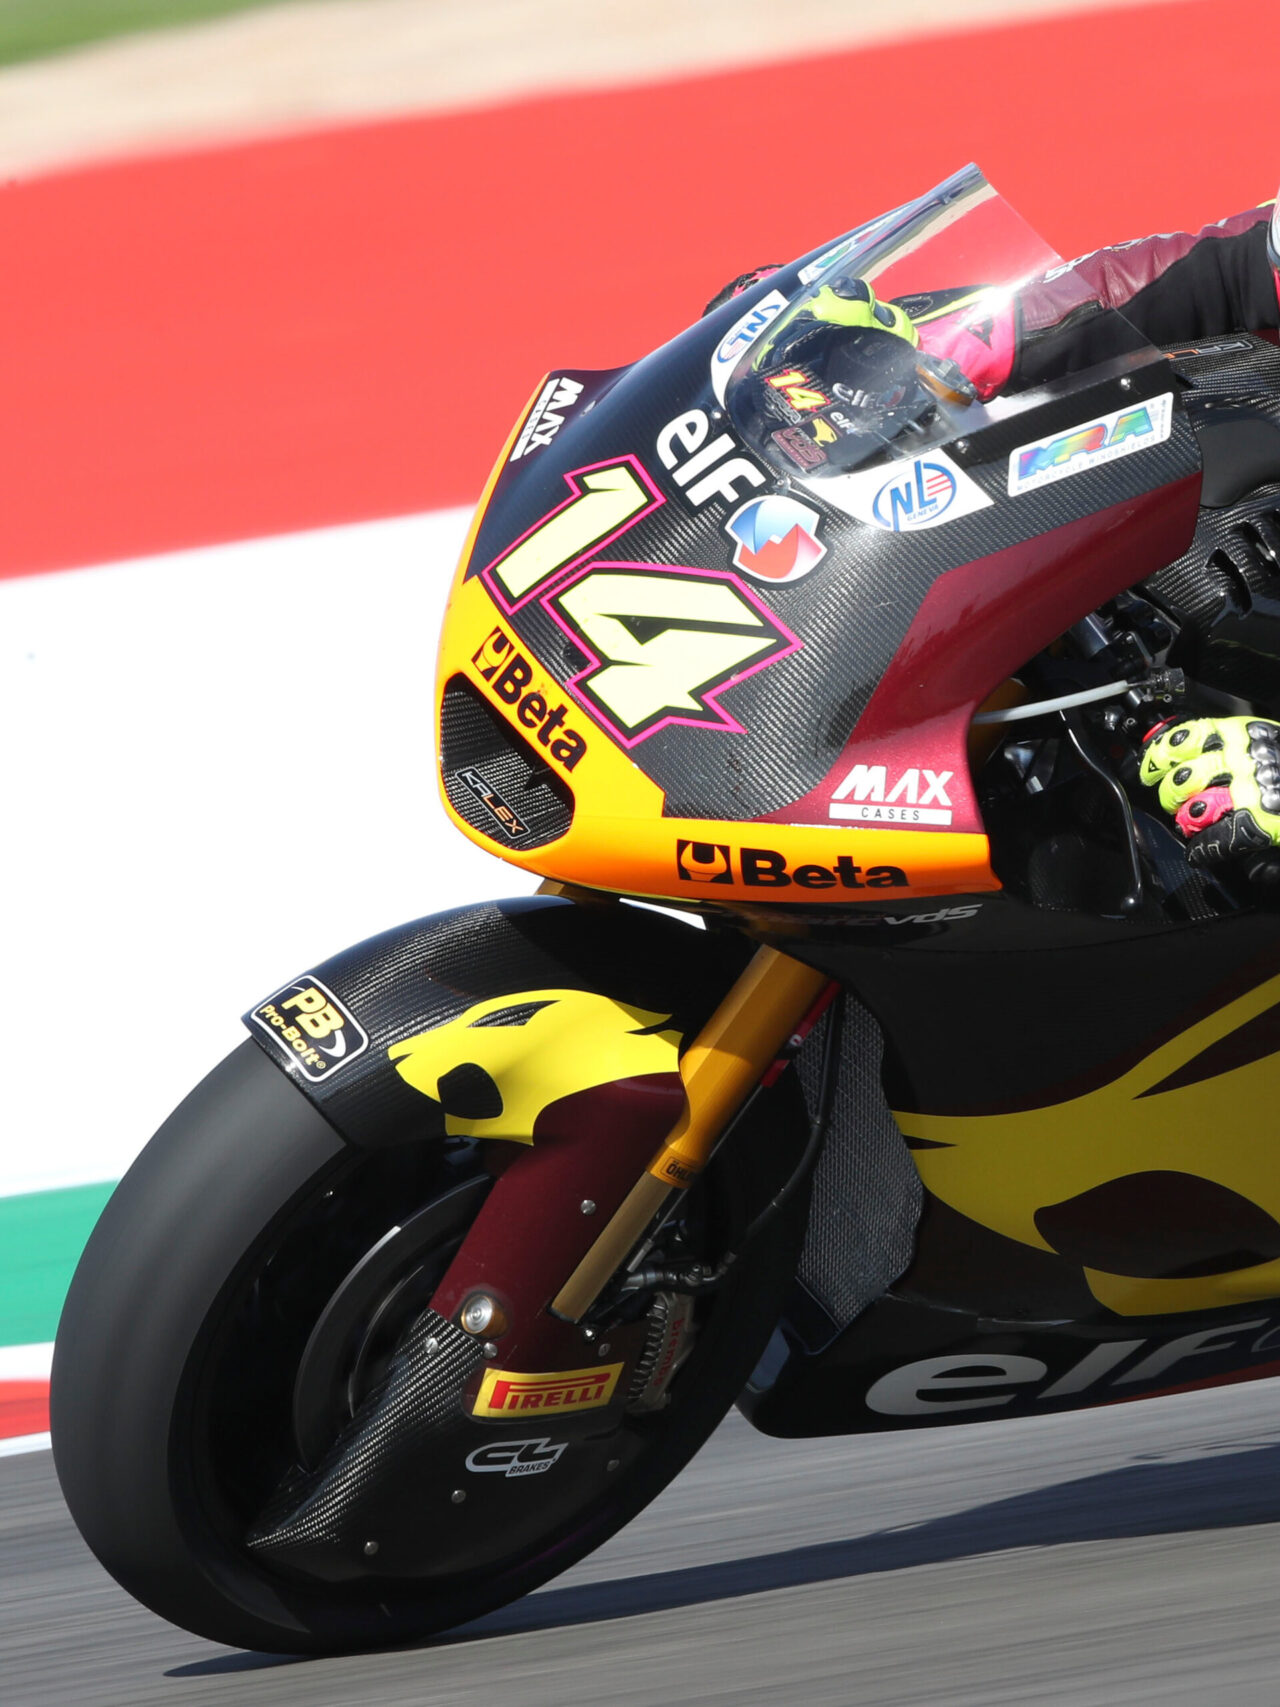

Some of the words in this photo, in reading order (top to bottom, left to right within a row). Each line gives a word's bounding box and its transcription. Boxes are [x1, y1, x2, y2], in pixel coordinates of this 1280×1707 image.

[523, 376, 585, 457] MAX
[764, 368, 833, 413] 14
[656, 409, 766, 507] elf
[1018, 406, 1154, 481] MRA
[487, 458, 797, 744] 14
[494, 655, 588, 775] Beta
[461, 770, 525, 837] KALEX
[829, 764, 955, 806] MAX
[861, 806, 922, 822] CASES
[739, 848, 910, 890] Beta
[281, 986, 345, 1040] PB
[488, 1371, 612, 1410] PIRELLI
[865, 1317, 1270, 1417] elf
[470, 1441, 563, 1469] CL
[508, 1460, 551, 1475] BRAKES
